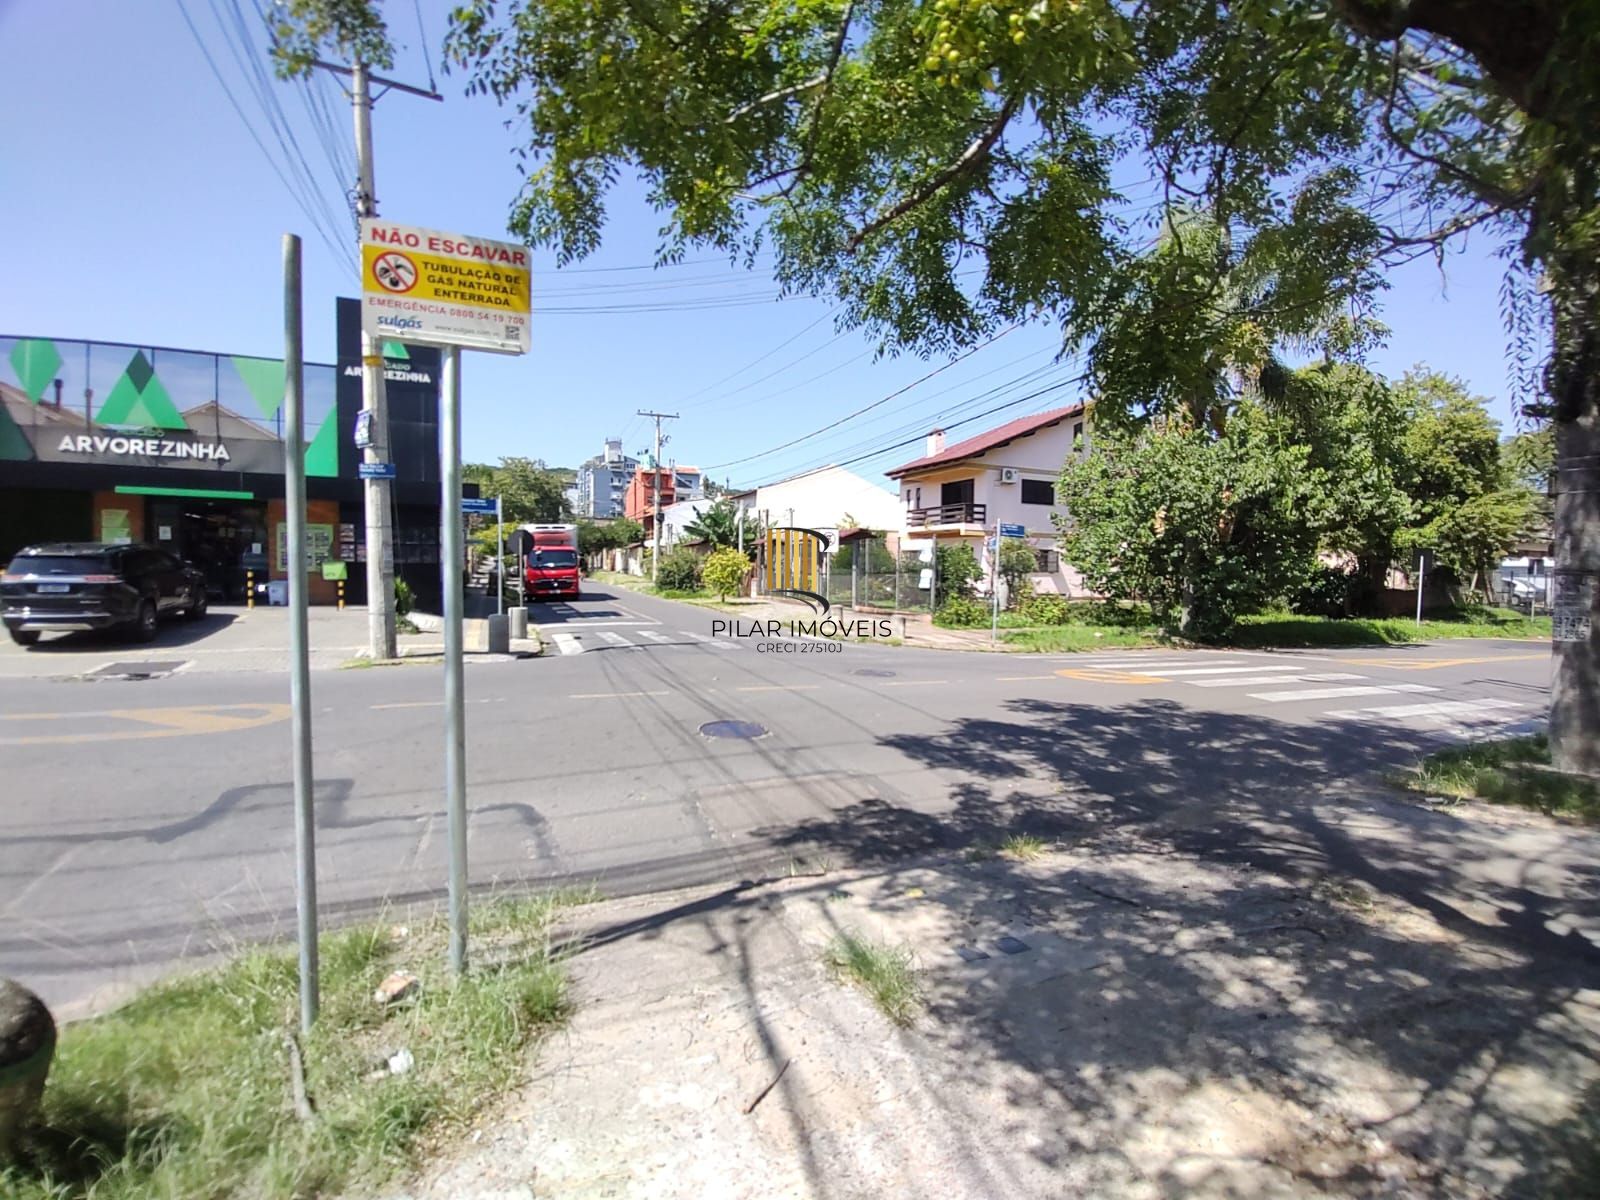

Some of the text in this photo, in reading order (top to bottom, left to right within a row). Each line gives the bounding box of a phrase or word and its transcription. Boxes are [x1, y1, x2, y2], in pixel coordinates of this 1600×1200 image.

[371, 226, 526, 266] NÃO ESCAVAR
[458, 280, 518, 296] NATURAL
[505, 274, 521, 285] DE
[434, 288, 511, 307] ENTERRADA
[369, 297, 446, 316] EMERGÊNCIA
[478, 311, 489, 321] 54
[494, 314, 504, 323] 19
[58, 435, 230, 460] ARVOREZINHA
